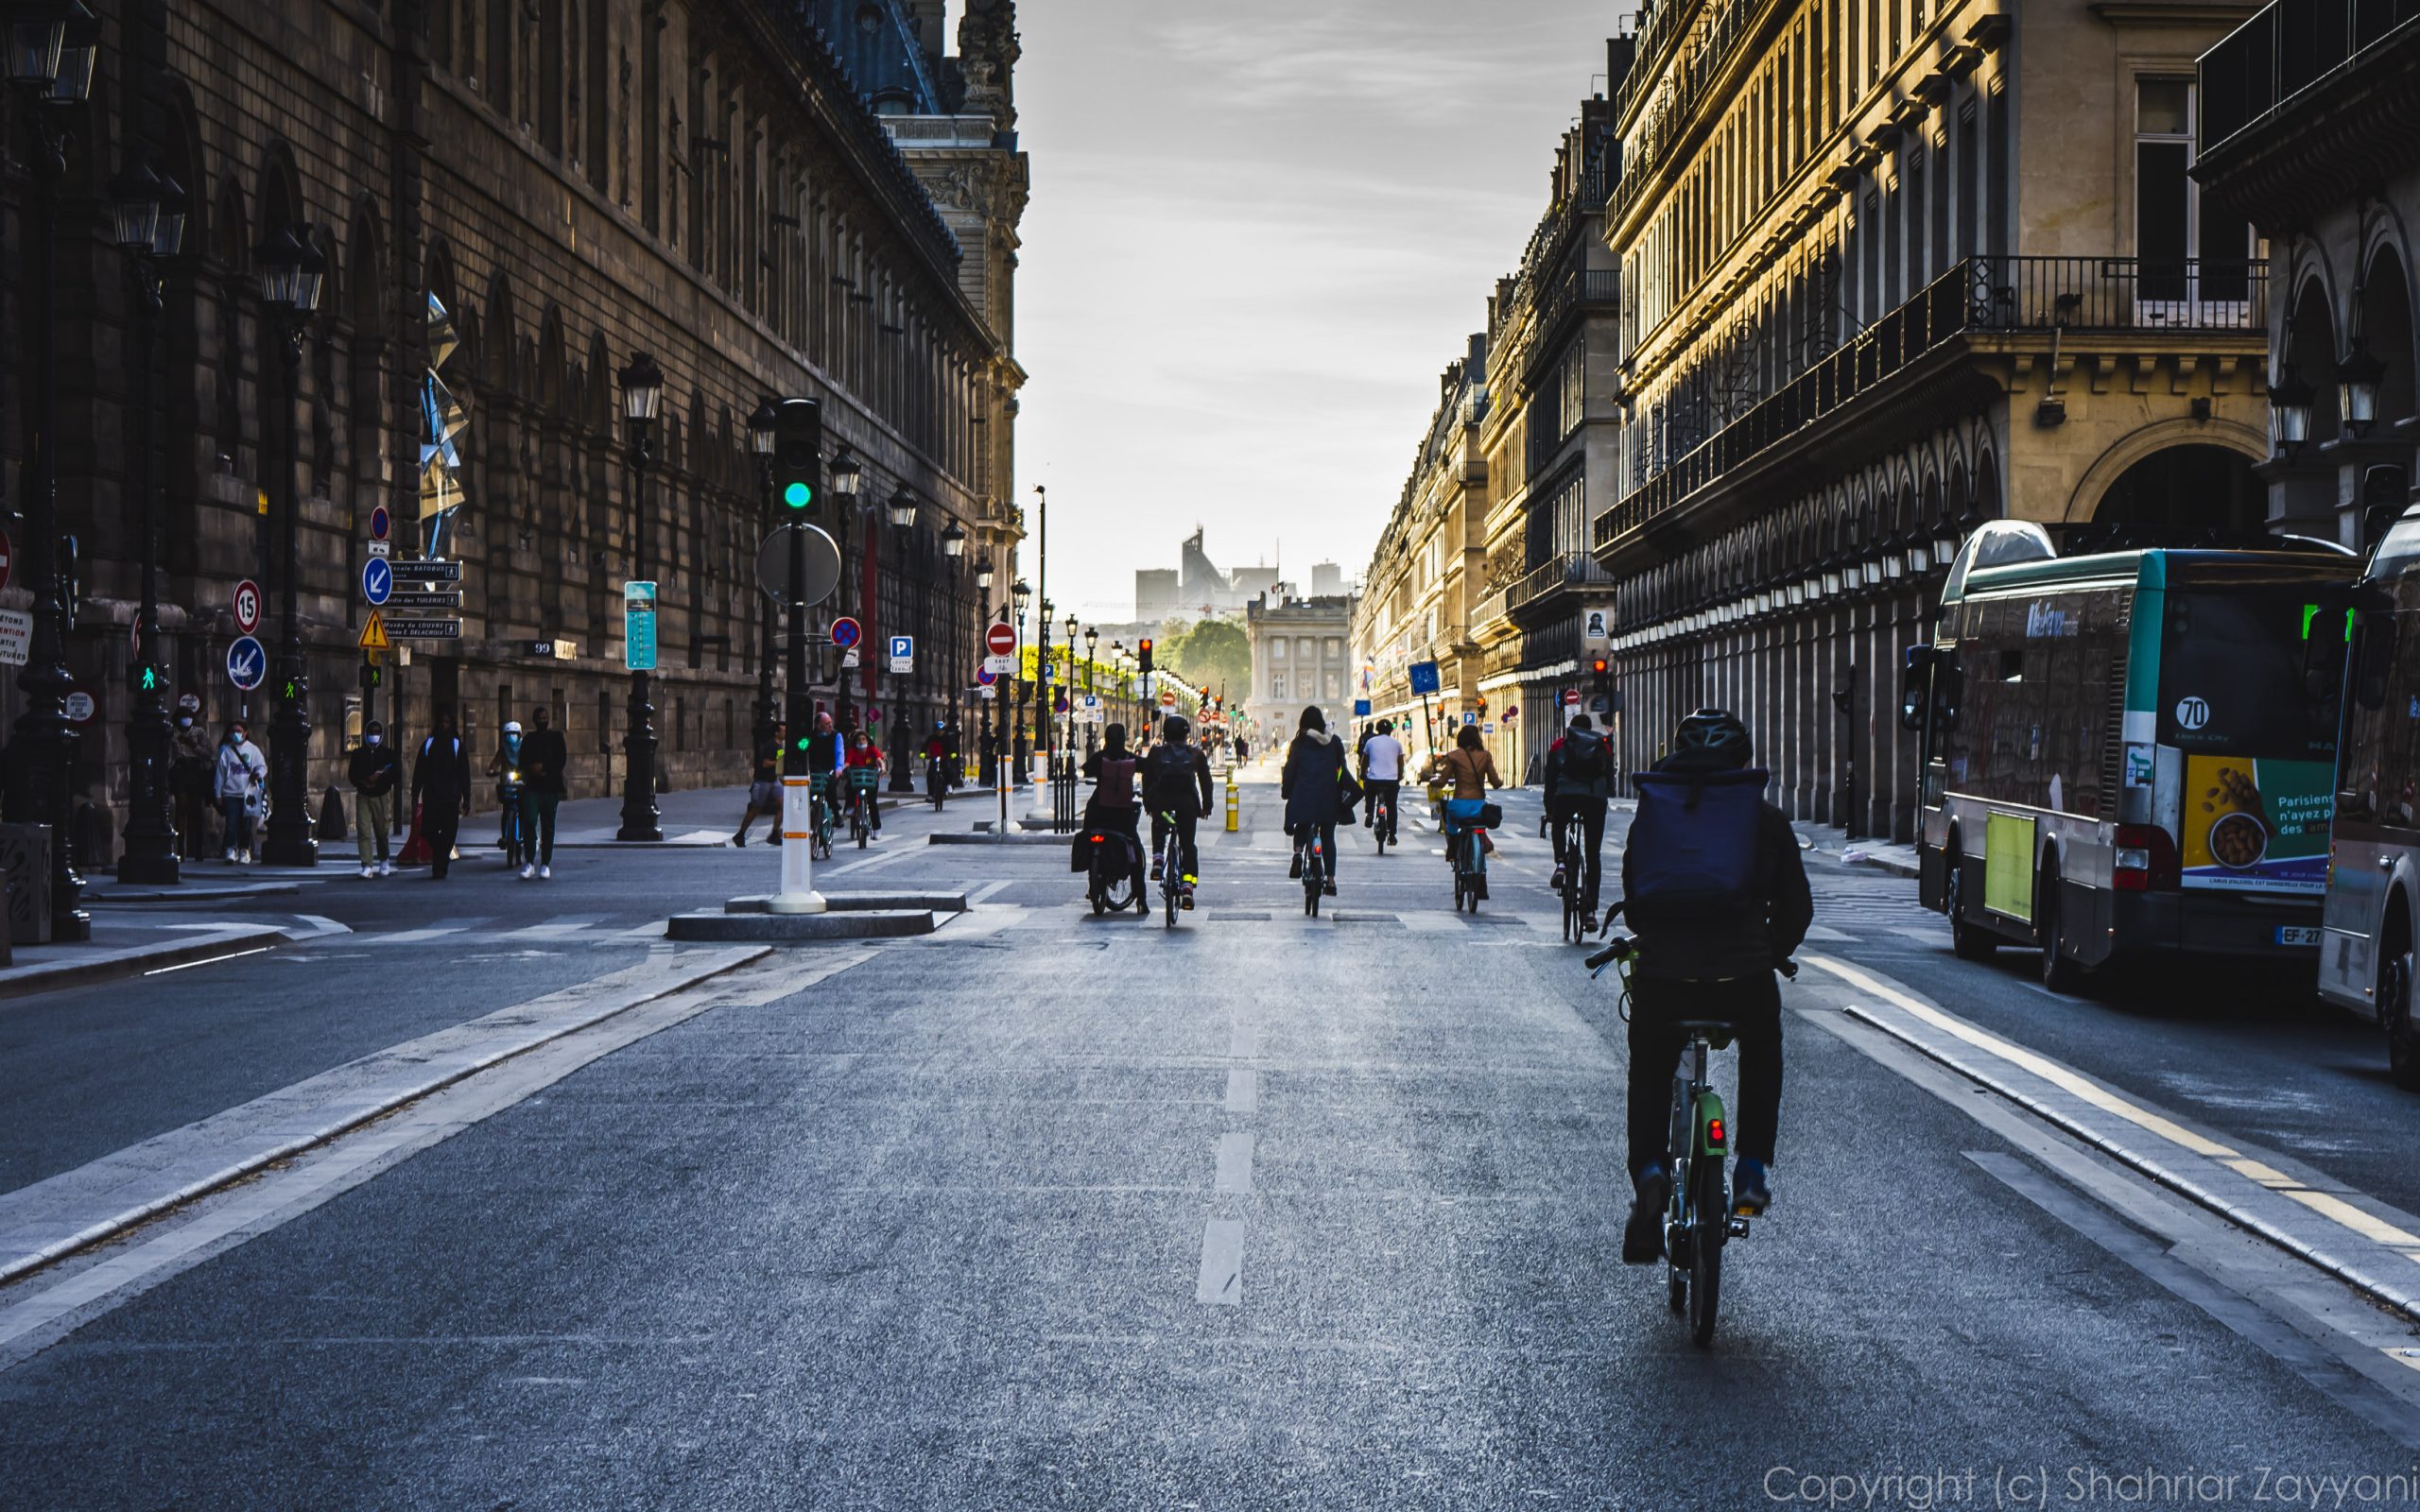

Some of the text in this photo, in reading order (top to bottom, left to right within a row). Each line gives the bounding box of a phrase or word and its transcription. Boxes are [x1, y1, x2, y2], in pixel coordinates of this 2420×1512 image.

[240, 596, 254, 618] 15
[535, 644, 550, 654] 99
[896, 641, 908, 655] P
[1466, 714, 1473, 723] P
[2182, 700, 2205, 727] 70
[2280, 810, 2320, 822] n'ayez
[2281, 824, 2302, 834] des
